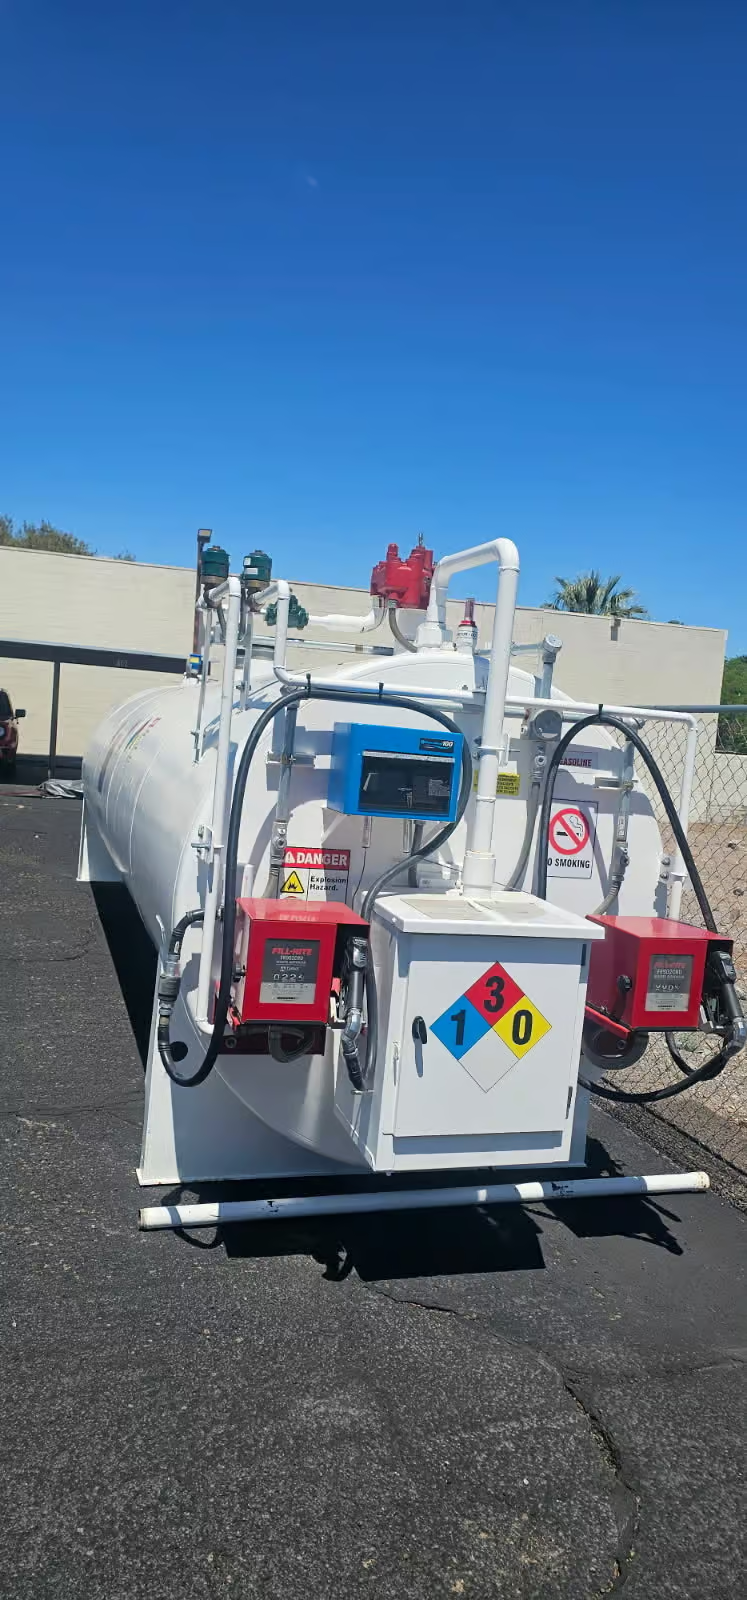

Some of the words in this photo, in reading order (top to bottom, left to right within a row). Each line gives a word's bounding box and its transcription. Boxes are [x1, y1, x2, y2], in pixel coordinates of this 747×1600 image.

[296, 852, 348, 866] DANGER
[554, 858, 590, 869] SMOKING
[310, 875, 347, 884] Explosion
[309, 883, 339, 891] Hazard.
[271, 947, 313, 956] FILL-RITE
[483, 975, 505, 1013] 3
[450, 1009, 466, 1046] 1
[511, 1009, 533, 1046] 0
